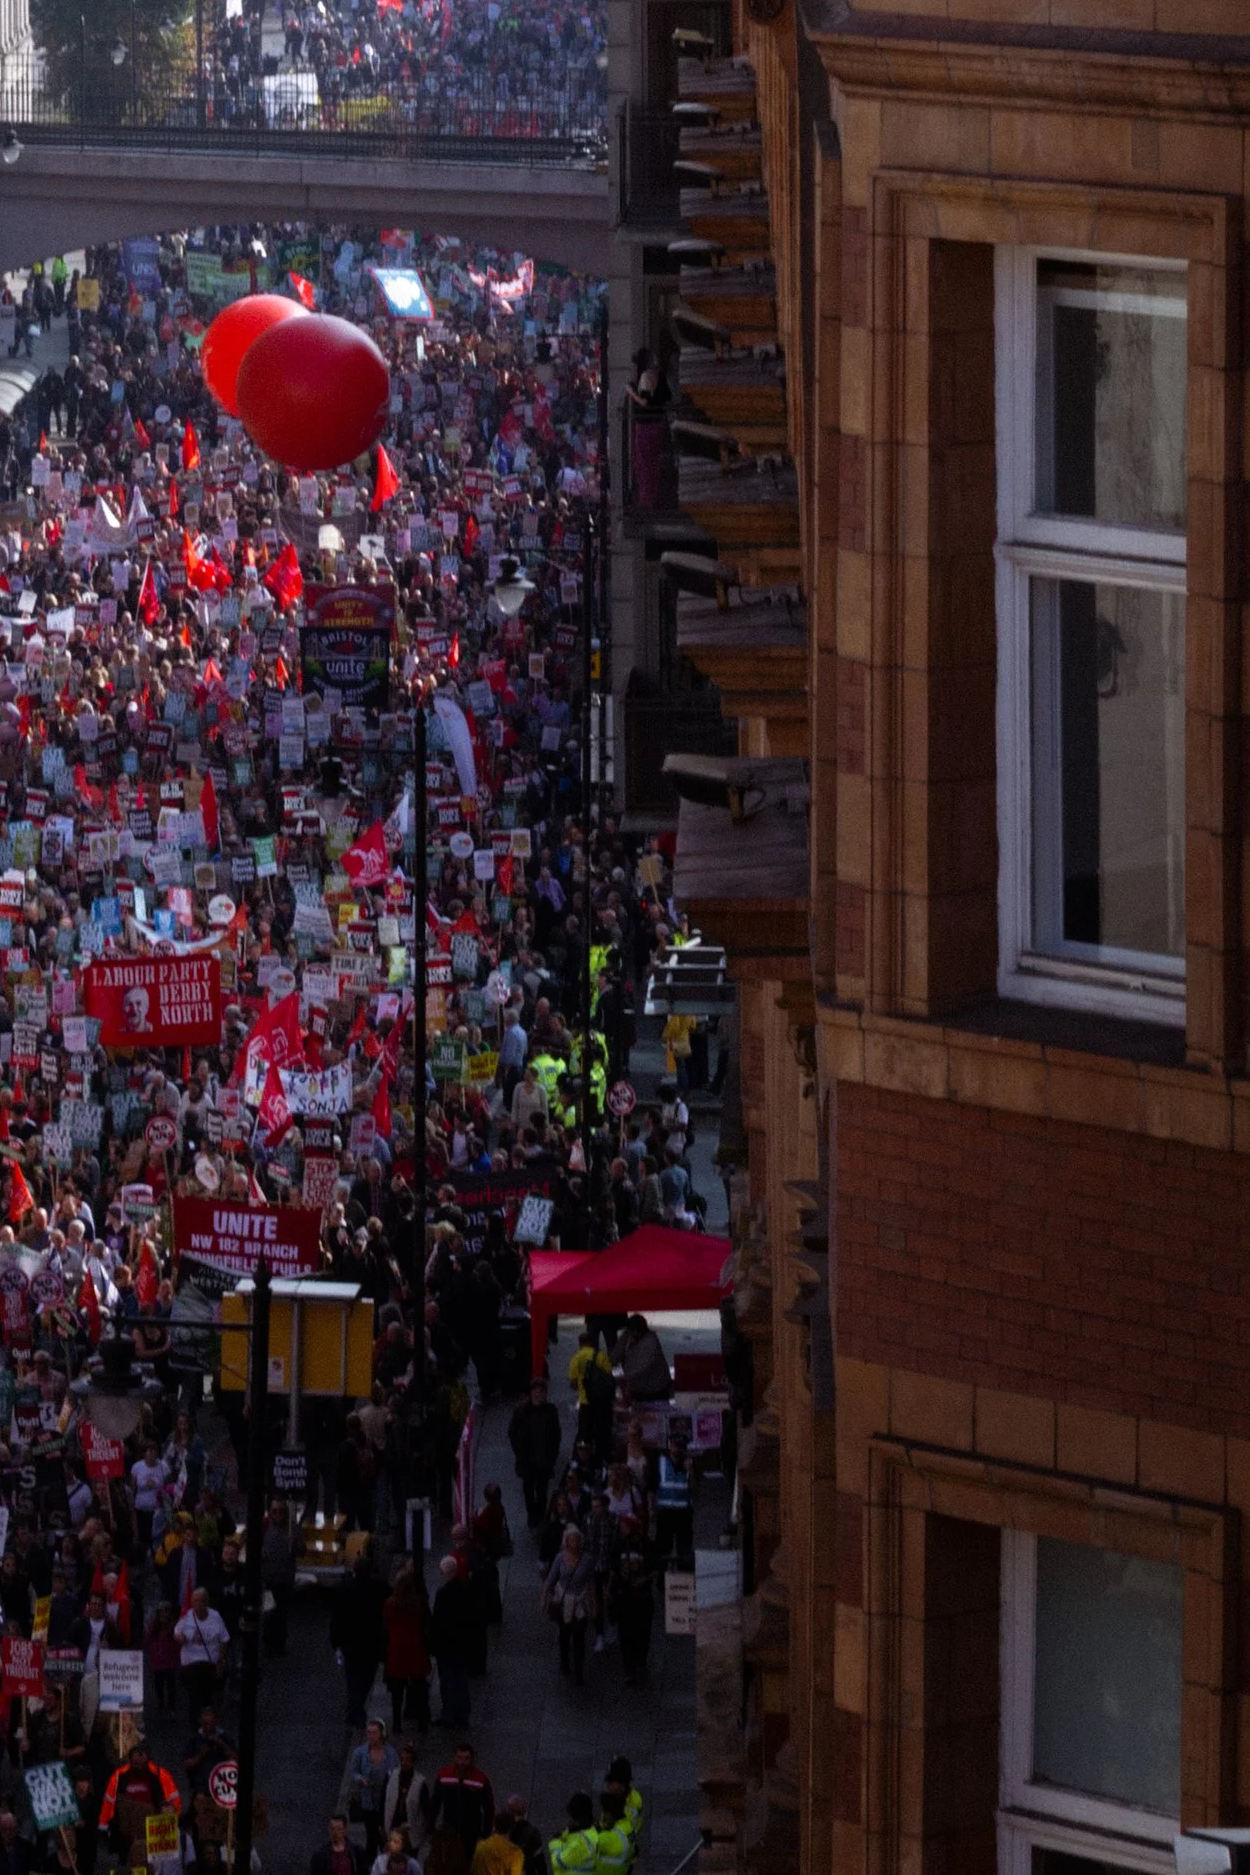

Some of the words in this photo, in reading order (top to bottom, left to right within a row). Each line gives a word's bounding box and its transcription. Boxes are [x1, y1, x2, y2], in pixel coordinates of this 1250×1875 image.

[320, 630, 368, 645] BRISTOL
[326, 659, 364, 674] unite
[92, 965, 156, 987] LABOUR
[158, 960, 212, 984] PARTY
[159, 981, 211, 1003] DERBY
[161, 1002, 214, 1026] NORTH
[524, 1197, 553, 1210] CUT
[212, 1211, 278, 1240] UNITE
[191, 1233, 213, 1250] NW
[244, 1240, 299, 1260] BRANCH
[274, 1454, 307, 1467] Don't
[273, 1466, 308, 1478] Bomb
[274, 1477, 306, 1491] Syria
[9, 1640, 33, 1655] JOBS
[11, 1654, 32, 1667] NOT
[5, 1665, 39, 1681] TRIDENT
[103, 1663, 140, 1674] Refugees
[111, 1681, 131, 1691] here
[25, 1762, 66, 1784] CUT
[216, 1770, 238, 1781] NO
[29, 1777, 72, 1796] WAR
[33, 1792, 75, 1814] NOT
